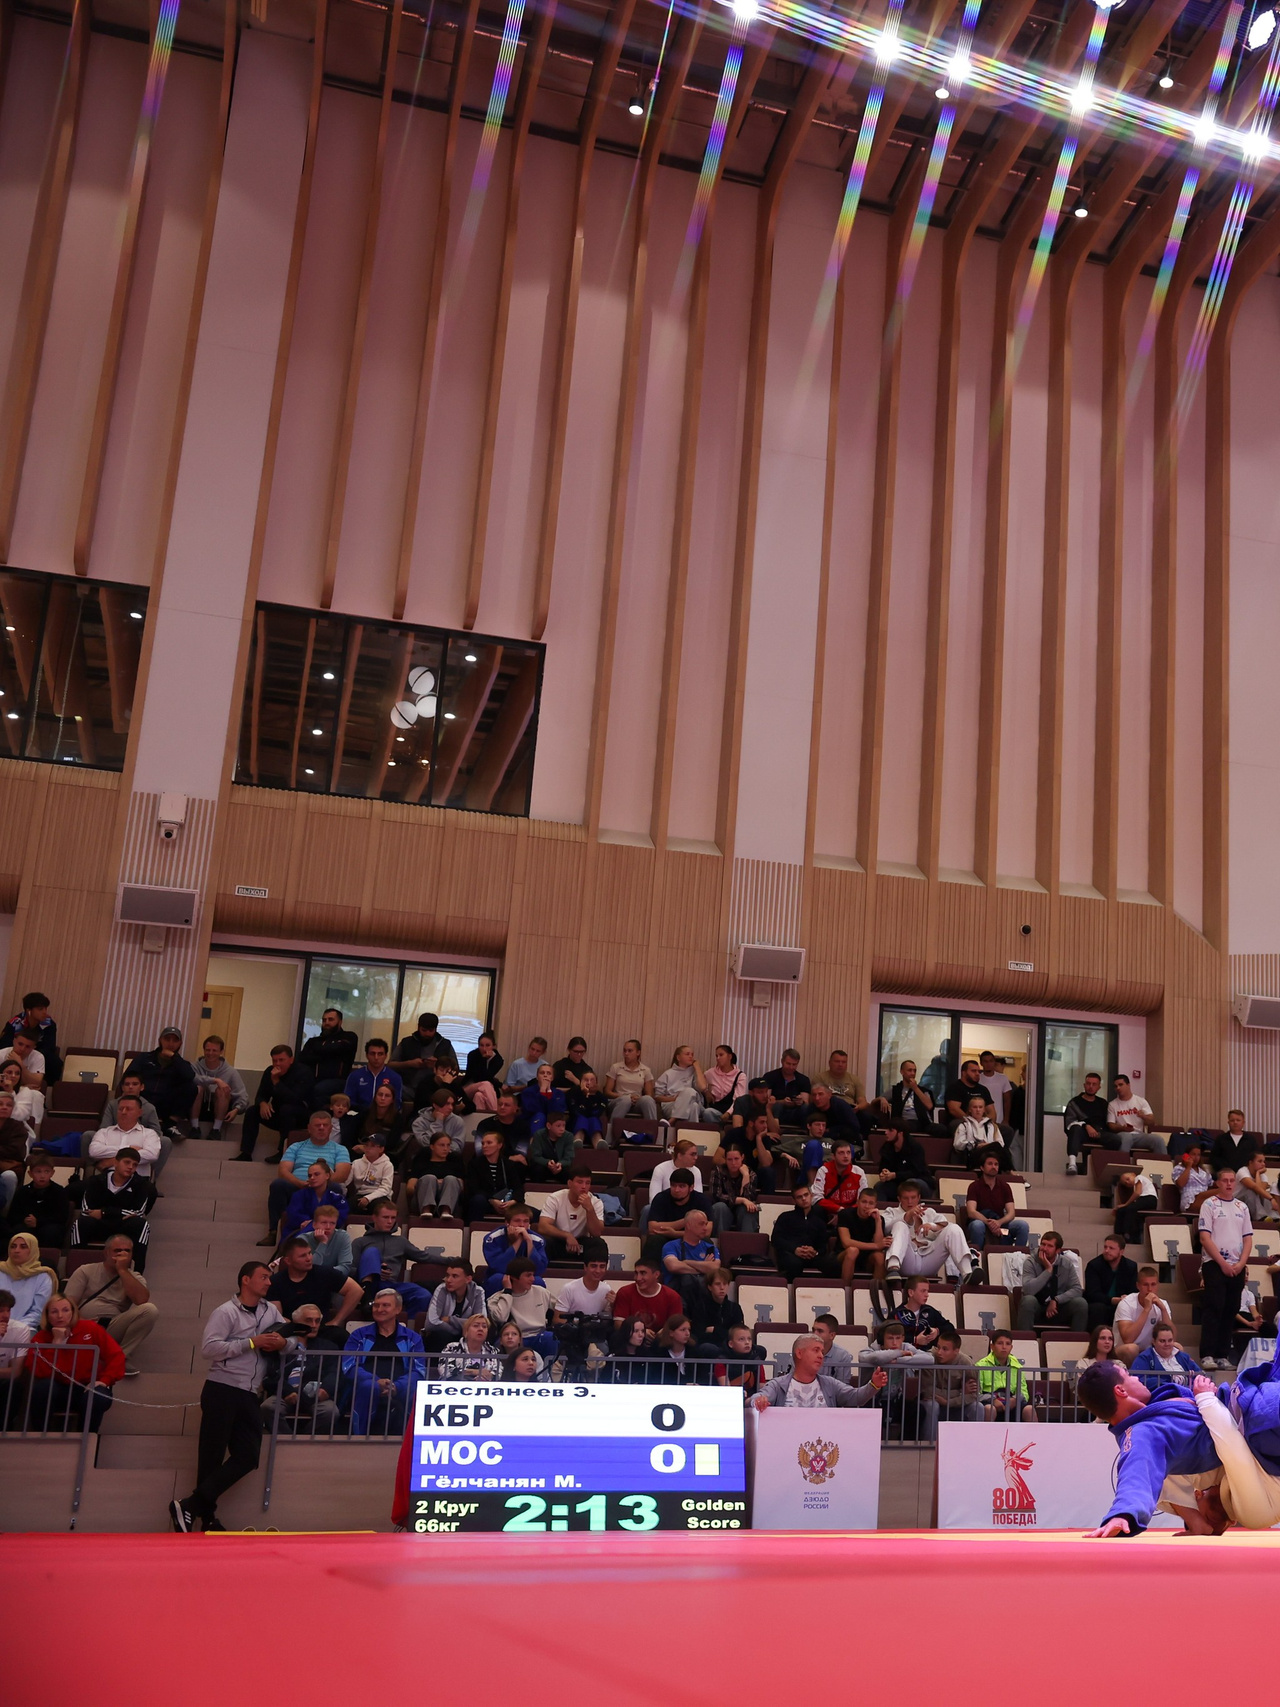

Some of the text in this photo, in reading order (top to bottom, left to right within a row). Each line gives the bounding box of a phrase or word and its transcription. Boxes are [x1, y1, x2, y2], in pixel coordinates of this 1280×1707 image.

[427, 1384, 597, 1398] Бесланеев Э.
[423, 1403, 686, 1432] КБР 0
[419, 1440, 687, 1474] МОС 0
[420, 1474, 582, 1488] Гёлчанян М.
[681, 1498, 746, 1511] Golden
[993, 1488, 1017, 1509] 80
[415, 1500, 479, 1516] 2 Круг
[502, 1494, 661, 1532] 2:13
[414, 1518, 460, 1532] 66кг
[687, 1516, 741, 1529] Score
[993, 1513, 1037, 1526] ПОБЕДА!
